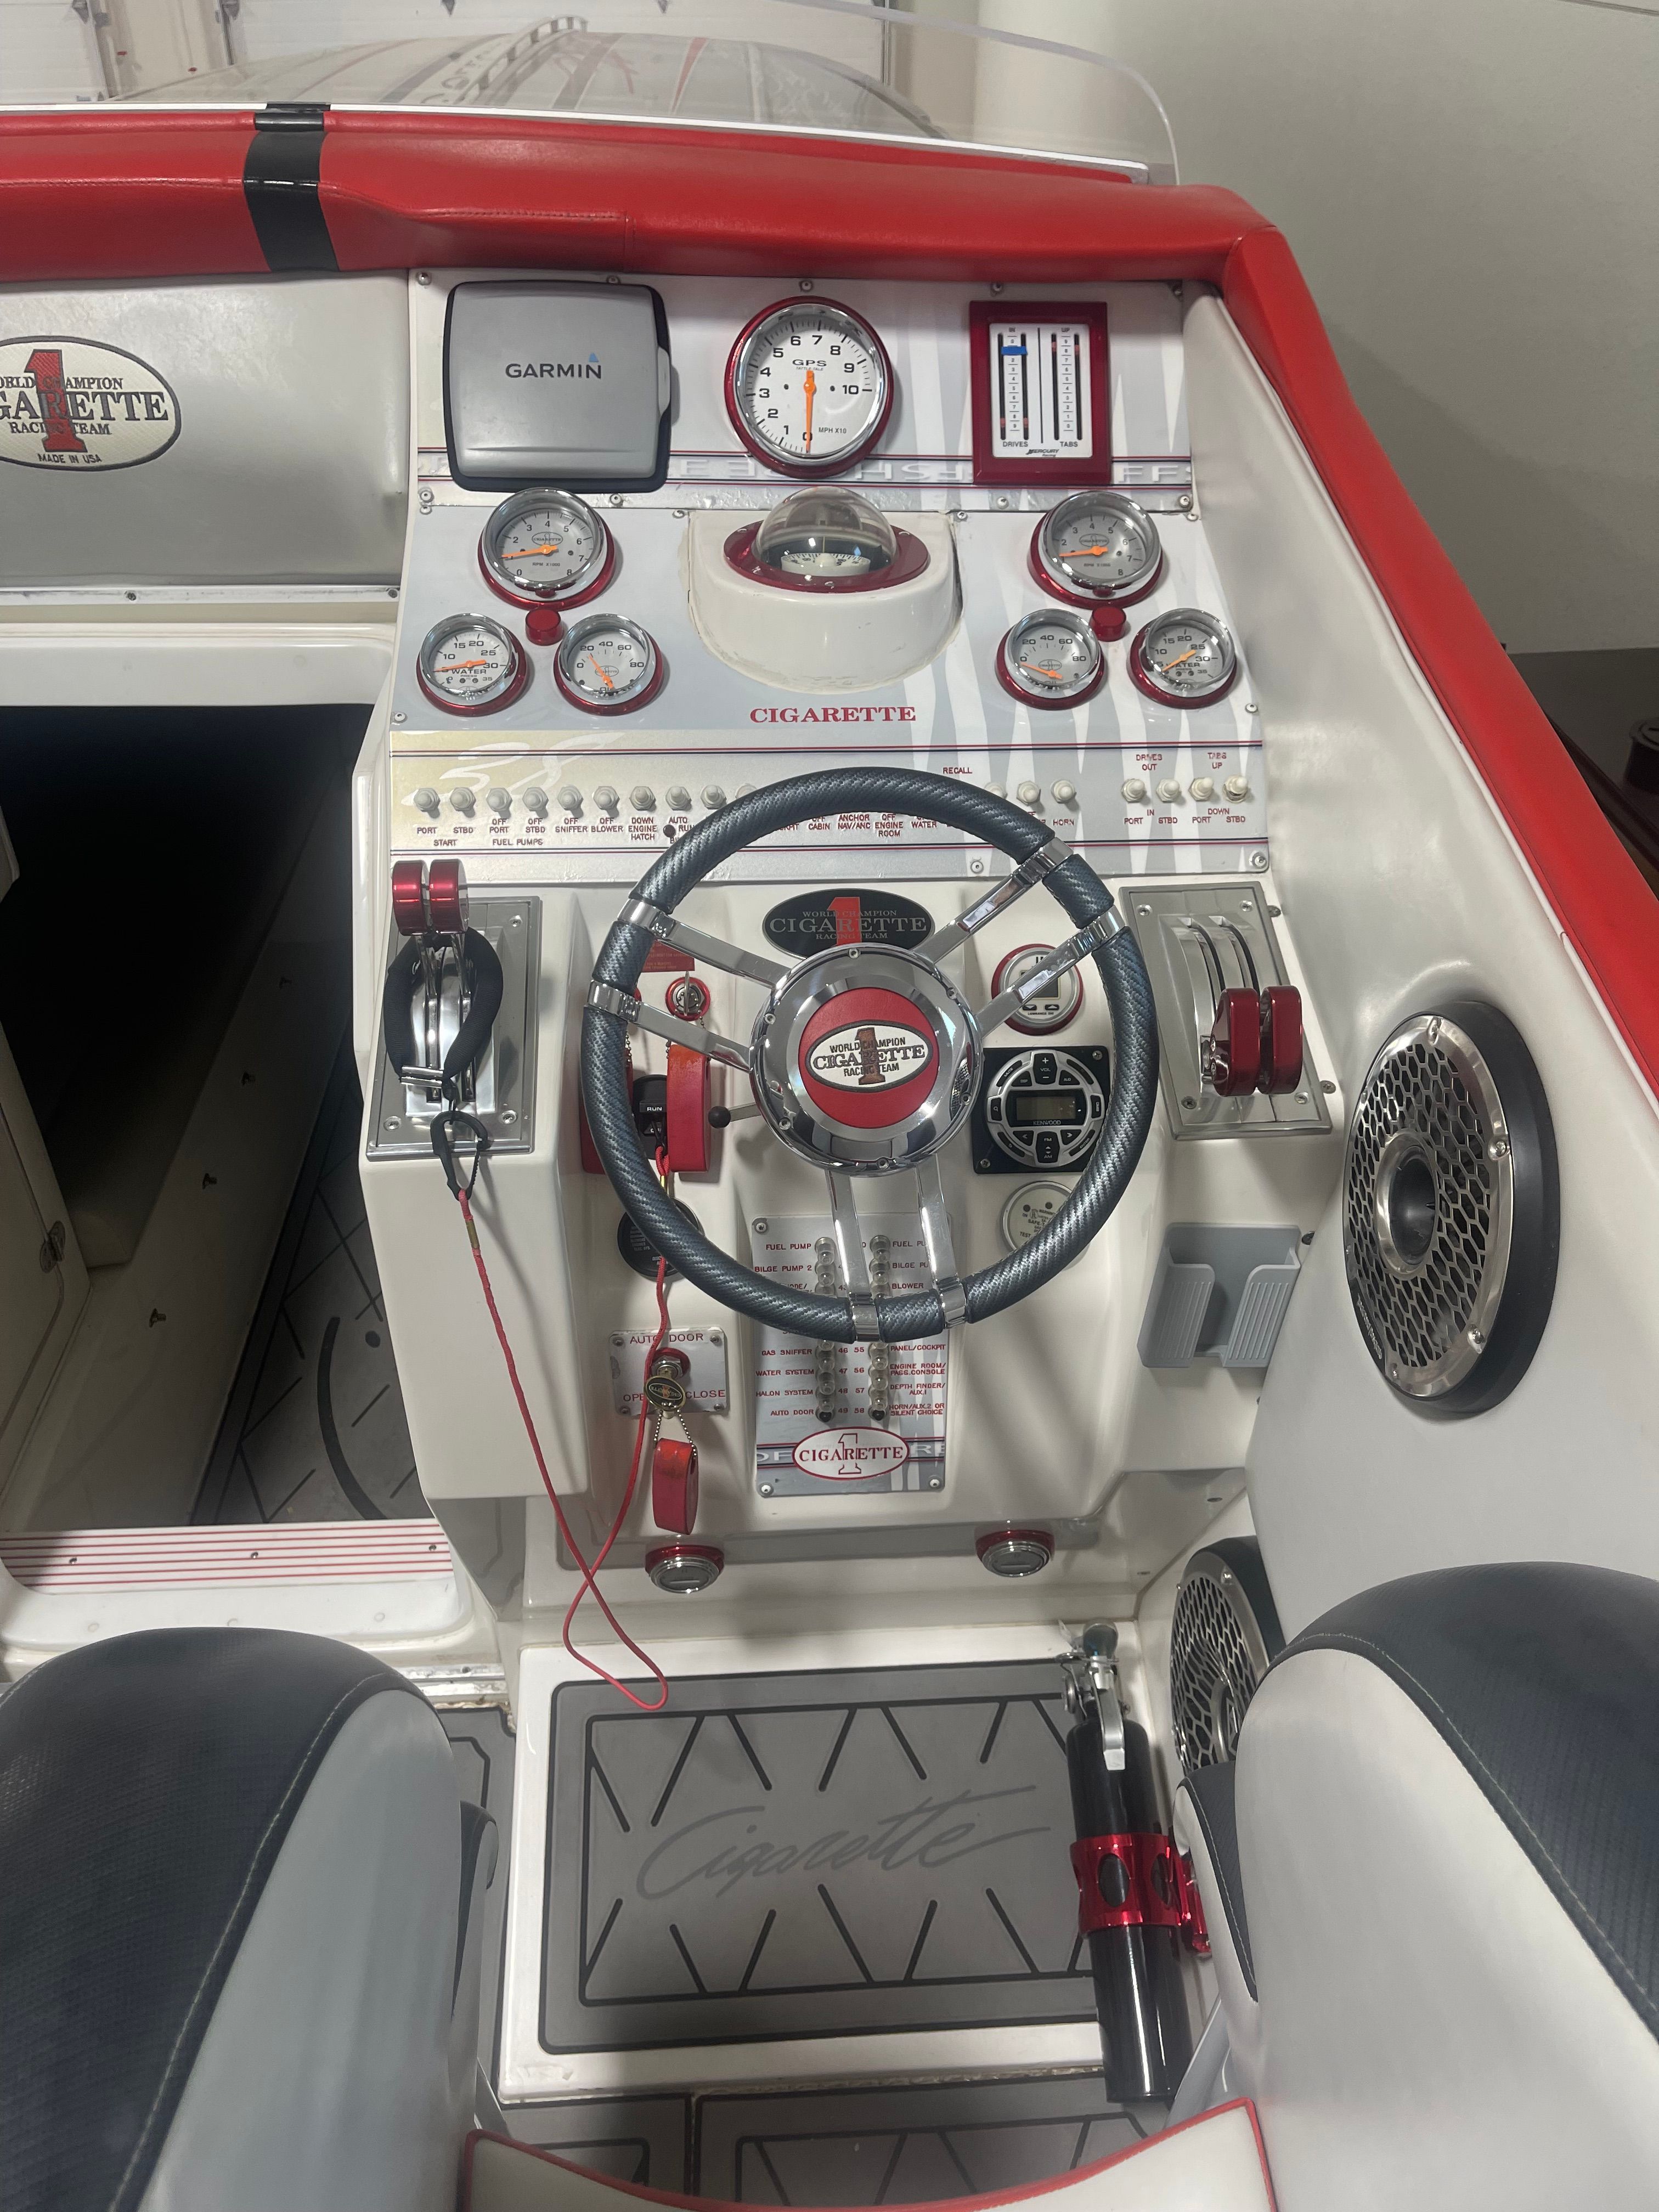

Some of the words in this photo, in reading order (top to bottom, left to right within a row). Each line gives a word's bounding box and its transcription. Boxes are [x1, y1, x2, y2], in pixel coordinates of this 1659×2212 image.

[791, 336, 800, 346] 6
[812, 335, 822, 345] 7
[774, 348, 783, 358] 5
[831, 346, 840, 355] 8
[505, 363, 601, 379] GARMIN
[760, 367, 771, 376] 4
[844, 363, 854, 373] 9
[0, 377, 36, 388] ORLD
[759, 388, 769, 398] 3
[843, 385, 859, 394] 10
[0, 391, 168, 421] GARETTE
[768, 409, 778, 418] 2
[72, 423, 112, 435] TEAM
[784, 425, 788, 435] 1
[803, 432, 812, 441] 0
[38, 454, 65, 463] MADE
[70, 455, 78, 463] IN
[83, 455, 102, 463] USA
[750, 707, 916, 723] CIGARETTE
[770, 918, 927, 932] CIGARETTE
[830, 1042, 860, 1053] WORLD
[864, 1037, 905, 1049] CHAMPION
[813, 1045, 925, 1070] CIGARETTE
[879, 1063, 899, 1073] TEAM
[669, 1334, 703, 1342] DOOR
[799, 1447, 903, 1462] CIGARETTE
[637, 1785, 1051, 1900] Cigarette
